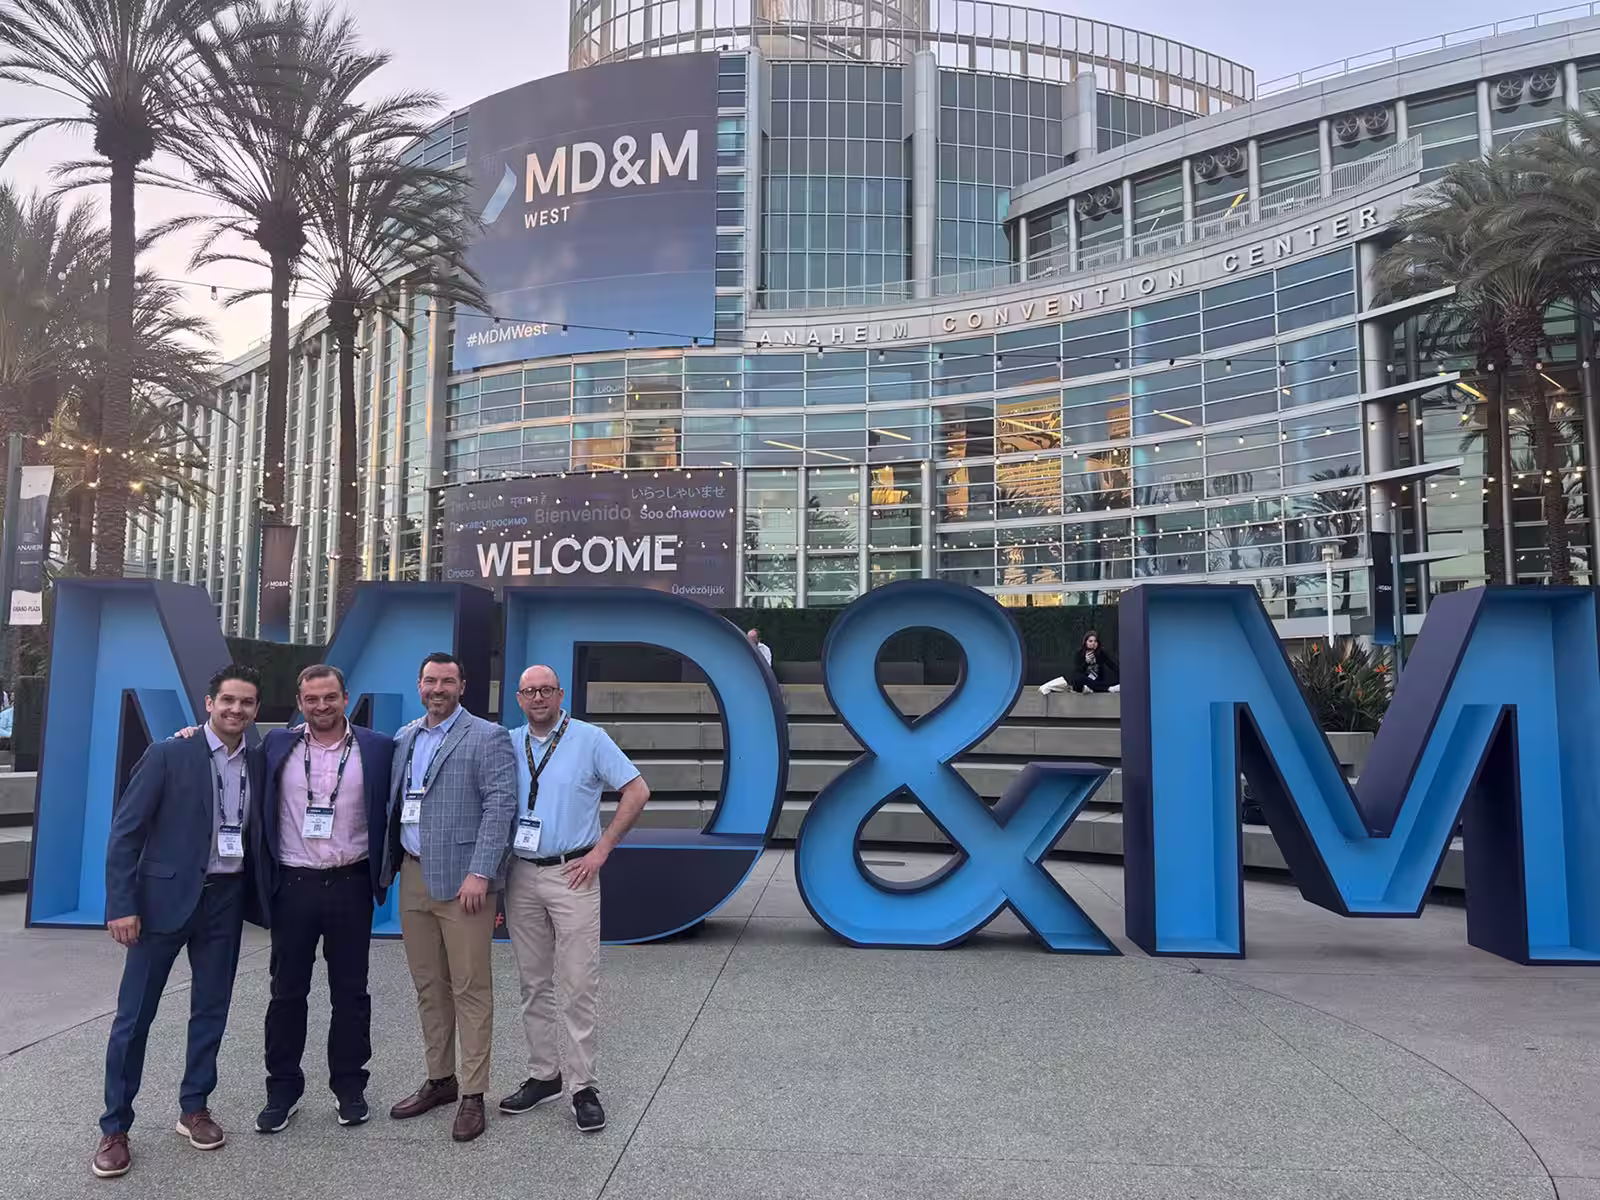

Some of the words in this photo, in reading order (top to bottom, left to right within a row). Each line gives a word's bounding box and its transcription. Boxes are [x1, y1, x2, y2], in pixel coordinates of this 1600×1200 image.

[525, 129, 698, 203] MD&M
[524, 206, 570, 229] WEST
[759, 321, 909, 346] ANAHEIM
[942, 268, 1185, 332] CONVENTION
[1223, 205, 1377, 272] CENTER
[466, 323, 548, 347] #MDMWest
[631, 486, 726, 500] いらっしゃいませ
[535, 504, 632, 524] Bienvenido
[640, 508, 664, 519] Soo
[476, 535, 678, 578] WELCOME
[25, 577, 1600, 965] MD&M
